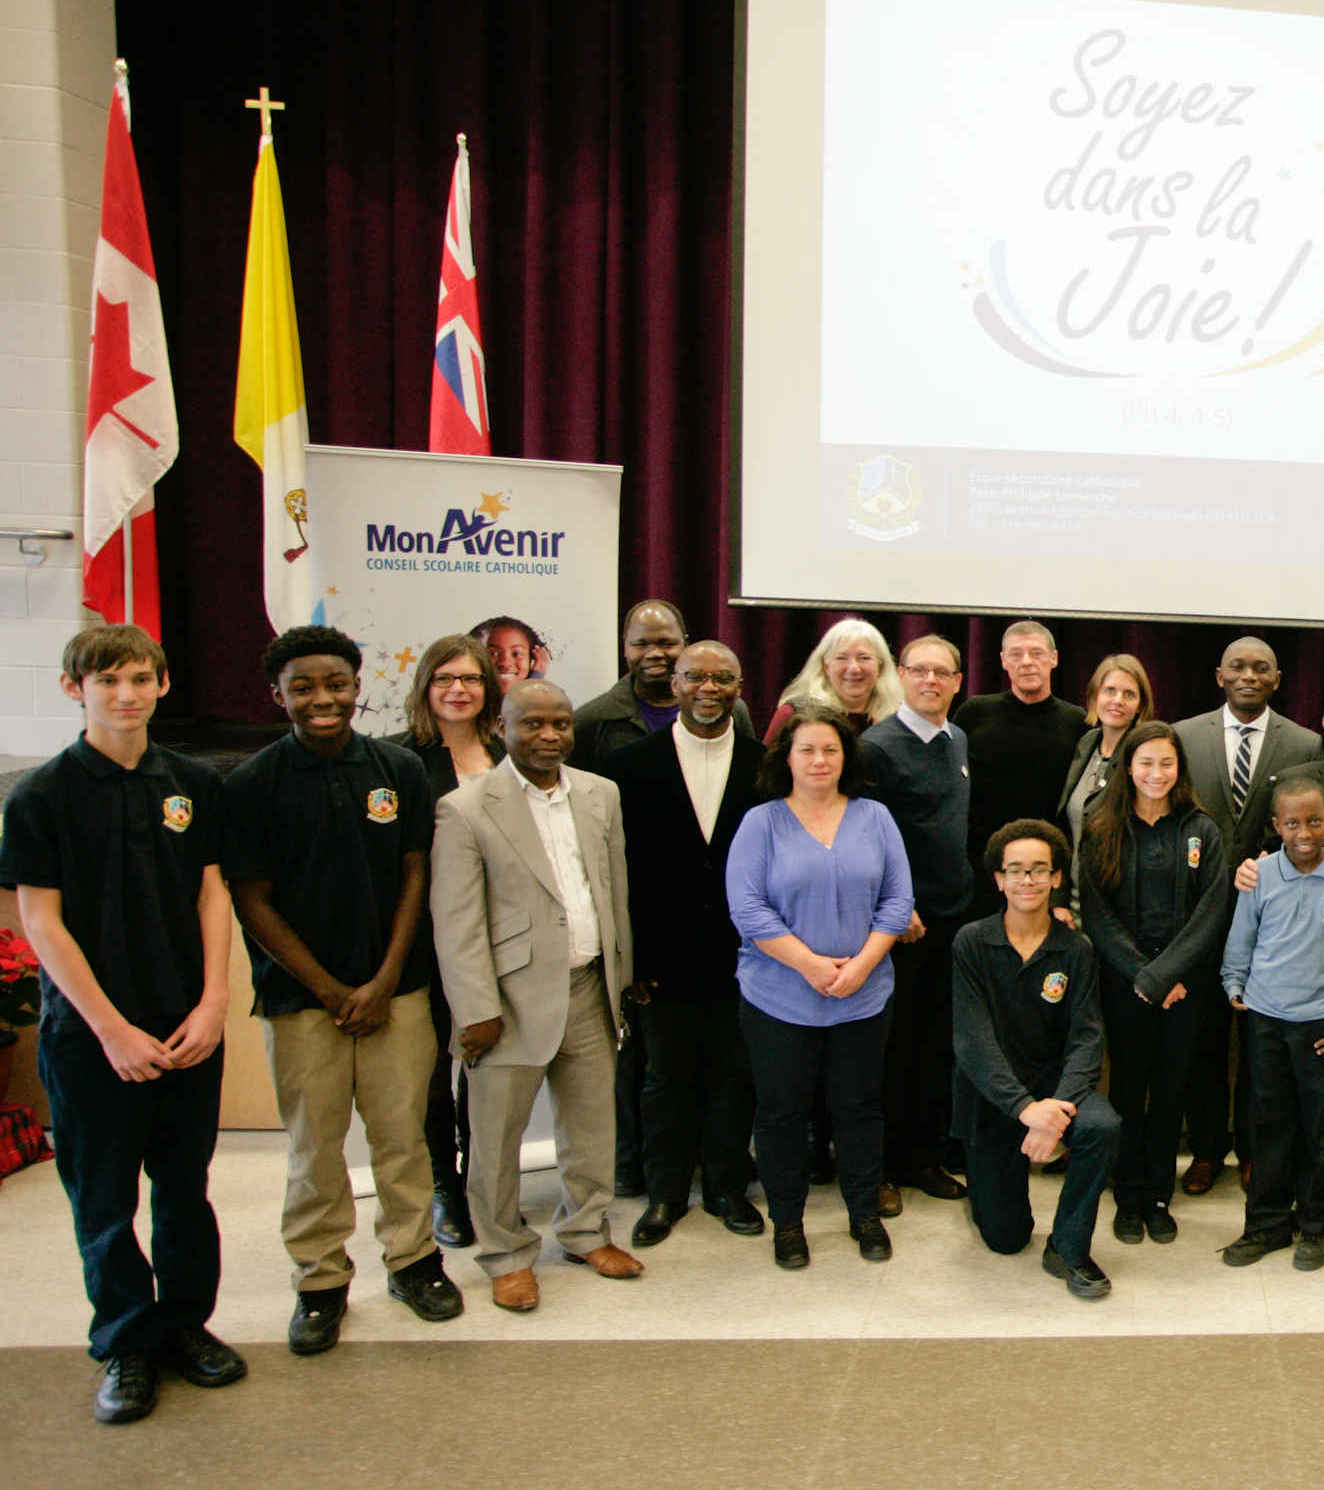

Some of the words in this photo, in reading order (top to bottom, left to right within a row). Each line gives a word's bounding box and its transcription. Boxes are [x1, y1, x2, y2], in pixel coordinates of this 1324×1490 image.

[1048, 28, 1256, 161] Soyez
[1043, 130, 1195, 221] dans
[1195, 154, 1262, 245] la
[366, 507, 566, 558] MonAvenir
[366, 557, 419, 572] CONSEIL
[423, 559, 481, 574] SCOLAIRE
[485, 560, 559, 576] CATHOLIQUE
